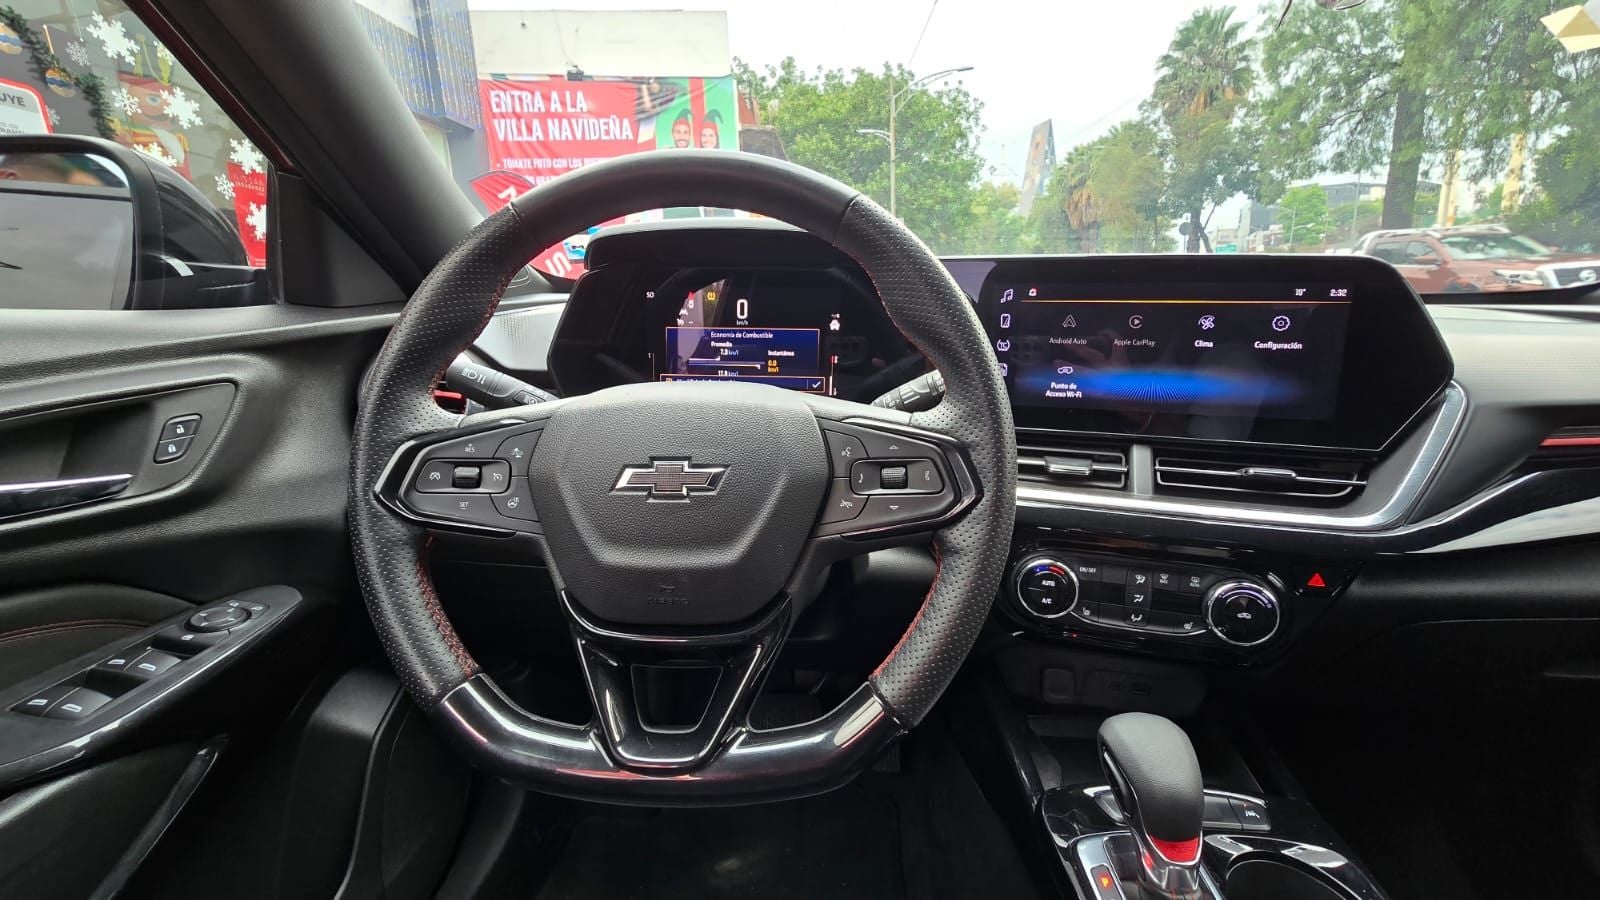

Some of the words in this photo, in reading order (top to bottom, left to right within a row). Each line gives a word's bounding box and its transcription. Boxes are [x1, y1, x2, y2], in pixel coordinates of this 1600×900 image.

[490, 90, 545, 113] ENTRA
[550, 90, 563, 113] A
[565, 90, 588, 113] LA
[493, 117, 544, 141] VILLA
[547, 115, 634, 140] NAVIDEÑA
[1329, 288, 1348, 297] 2:32
[736, 299, 748, 319] 0
[742, 331, 774, 339] Combustible
[1048, 337, 1072, 345] Android
[1113, 338, 1131, 346] Apple
[1132, 339, 1156, 347] CarPlay
[1194, 340, 1214, 348] Clima
[1254, 341, 1303, 350] Configuración
[1067, 390, 1082, 398] Wi-Fi
